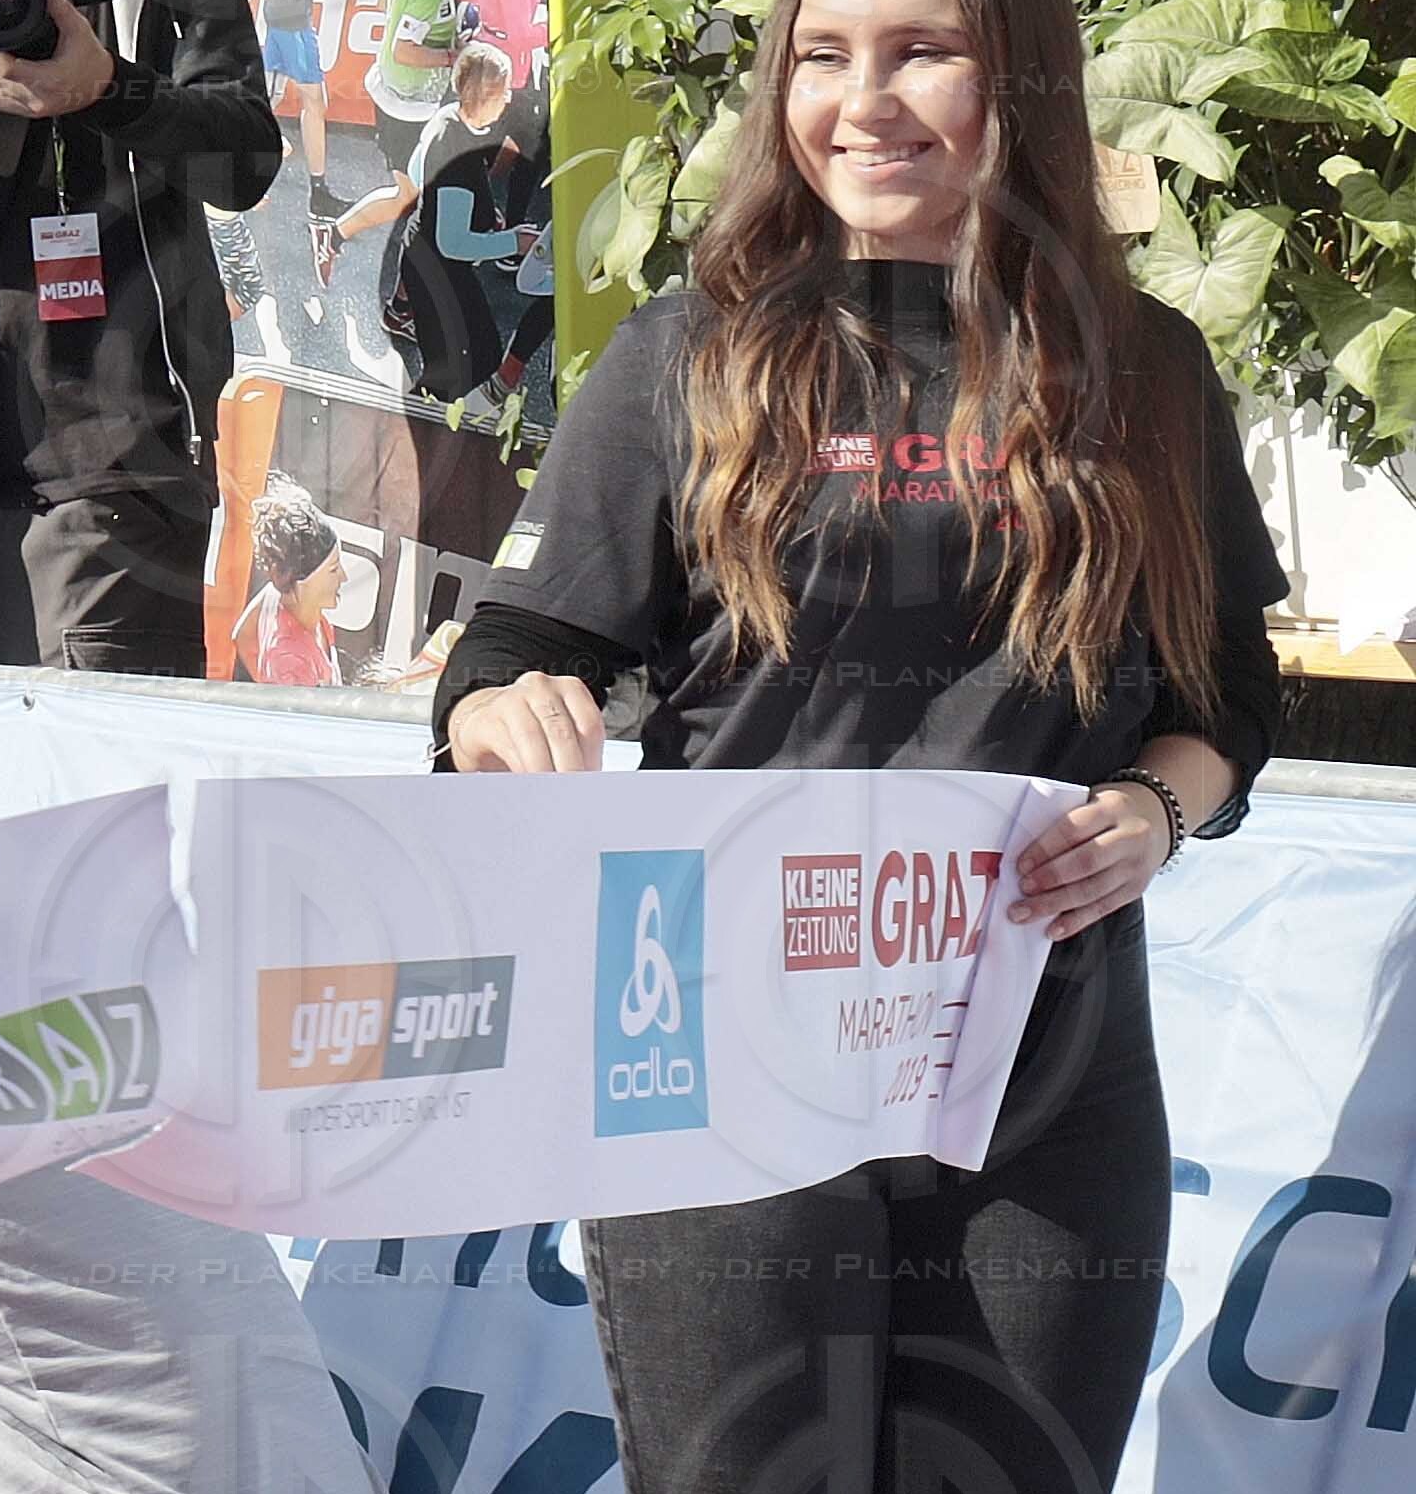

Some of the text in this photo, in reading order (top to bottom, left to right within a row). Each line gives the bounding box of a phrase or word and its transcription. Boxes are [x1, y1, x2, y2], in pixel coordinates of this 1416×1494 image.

[39, 279, 105, 301] MEDIA
[784, 866, 860, 910] KLEINE
[871, 849, 1004, 968] GRAZ
[785, 913, 859, 958] ZEITUNG
[289, 980, 500, 1069] giga sport
[607, 1045, 695, 1102] odlo
